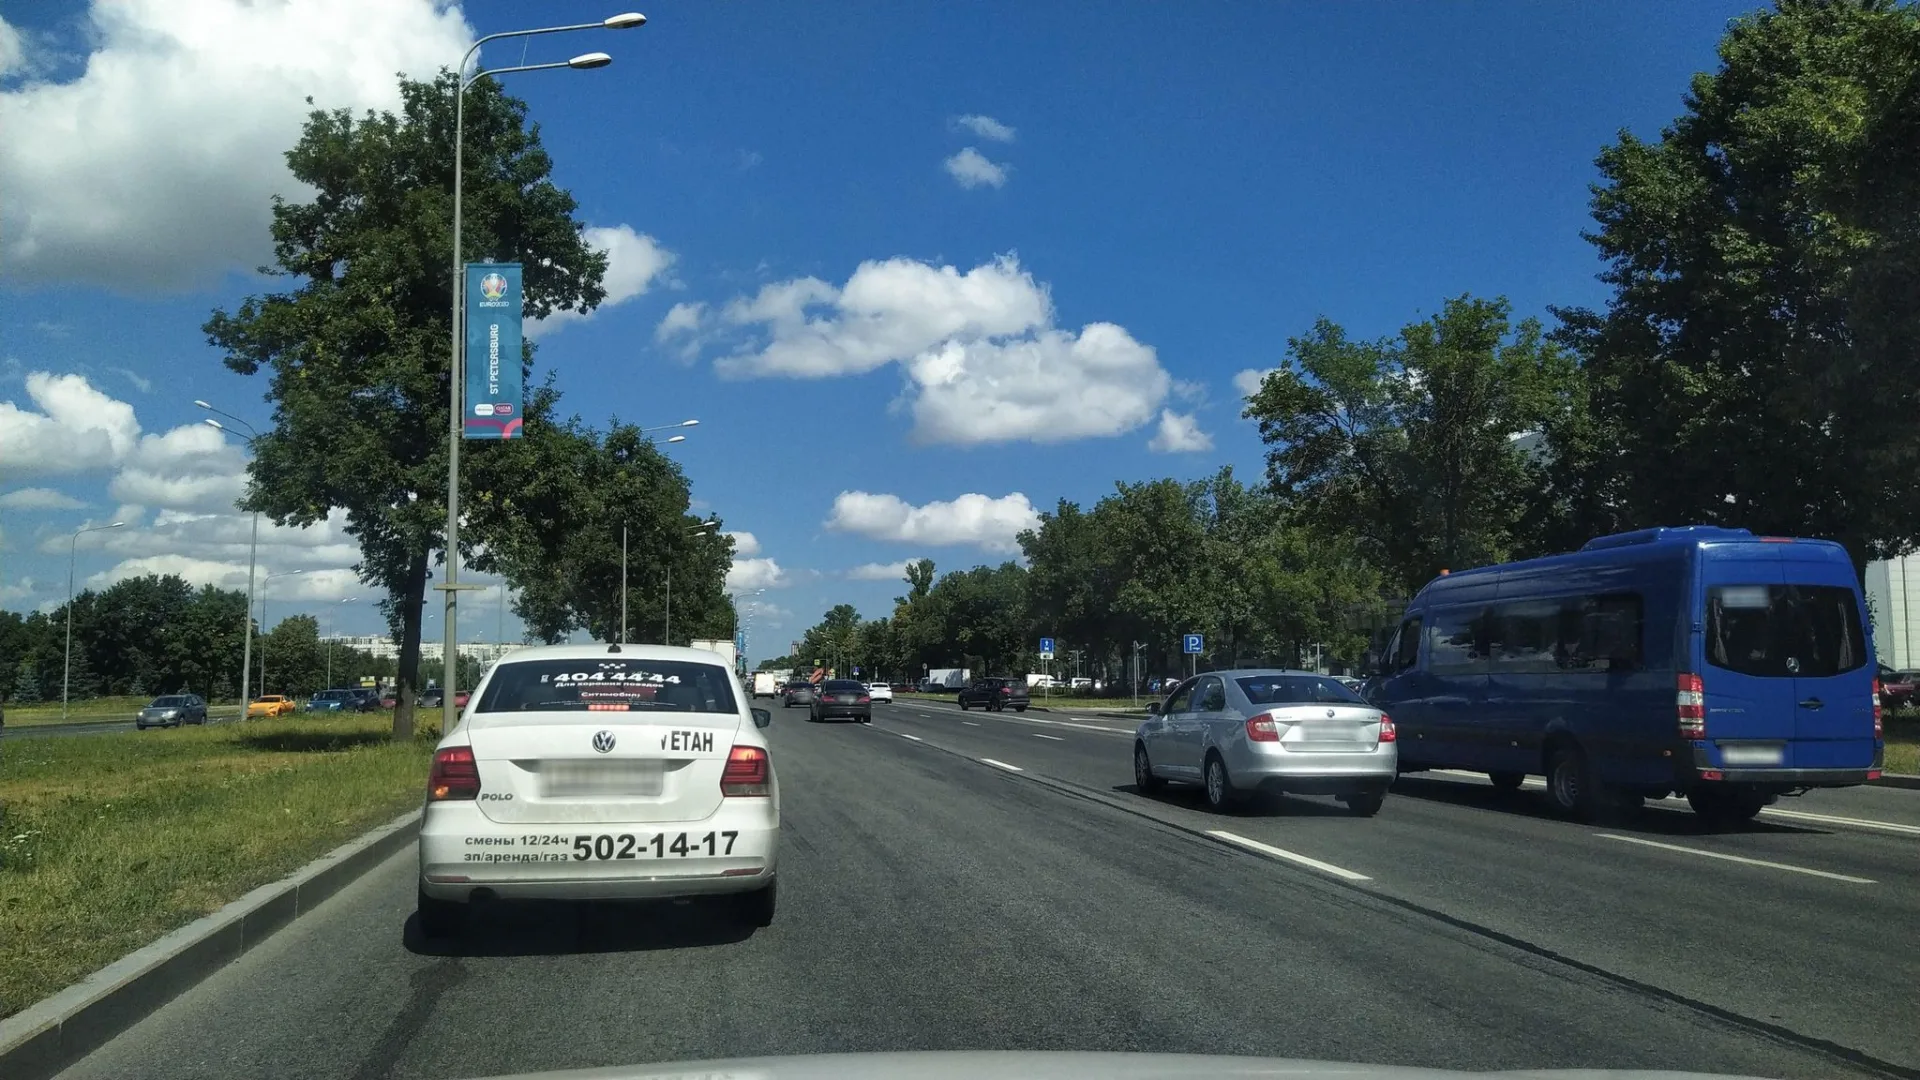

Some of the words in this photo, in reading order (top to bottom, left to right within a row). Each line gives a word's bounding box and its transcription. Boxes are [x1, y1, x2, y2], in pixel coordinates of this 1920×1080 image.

[490, 324, 499, 382] PETERSBURG
[490, 383, 499, 395] ST
[1189, 636, 1200, 651] P
[481, 793, 514, 801] POLO
[465, 837, 515, 846] смены
[520, 835, 568, 846] 12/24ч
[573, 830, 738, 861] 502-14-17
[464, 852, 568, 864] зп/аренда/газ
